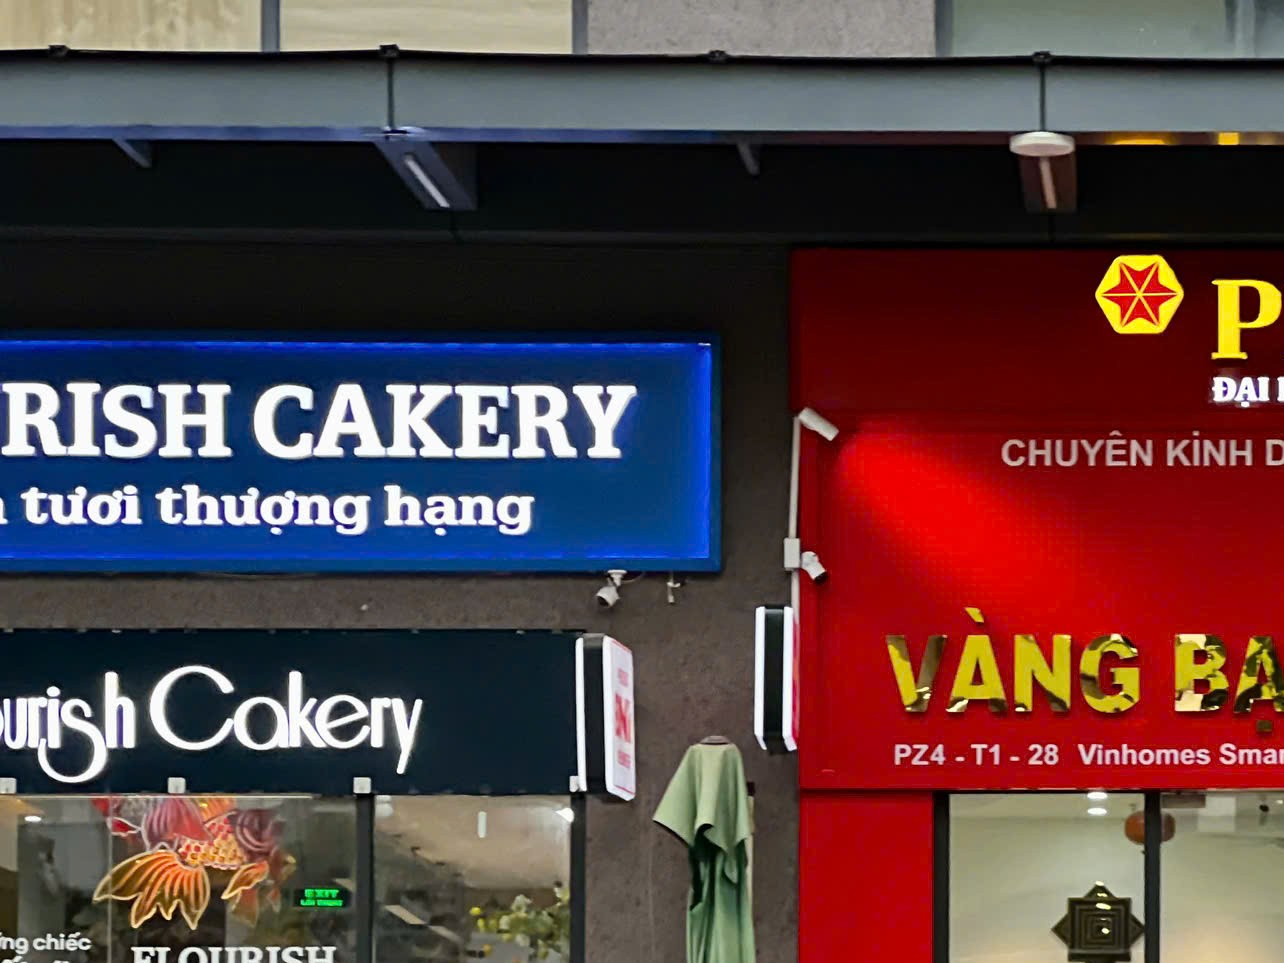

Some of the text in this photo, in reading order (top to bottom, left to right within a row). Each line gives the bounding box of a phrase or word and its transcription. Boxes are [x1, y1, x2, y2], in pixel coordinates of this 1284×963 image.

[1212, 376, 1270, 407] ĐẠI
[1, 383, 638, 460] RISH CAKERY
[1001, 430, 1154, 467] CHUYÊN
[20, 484, 143, 525] tươi
[155, 485, 371, 536] thượng
[384, 485, 535, 535] hạng
[885, 608, 1141, 713] VÀNG
[0, 665, 423, 783] urish Cakery
[894, 744, 945, 766] PZ4
[971, 744, 1000, 765] T1
[1028, 743, 1059, 766] 28
[1077, 743, 1211, 766] Vinhomes
[0, 932, 92, 955] ng chiếc
